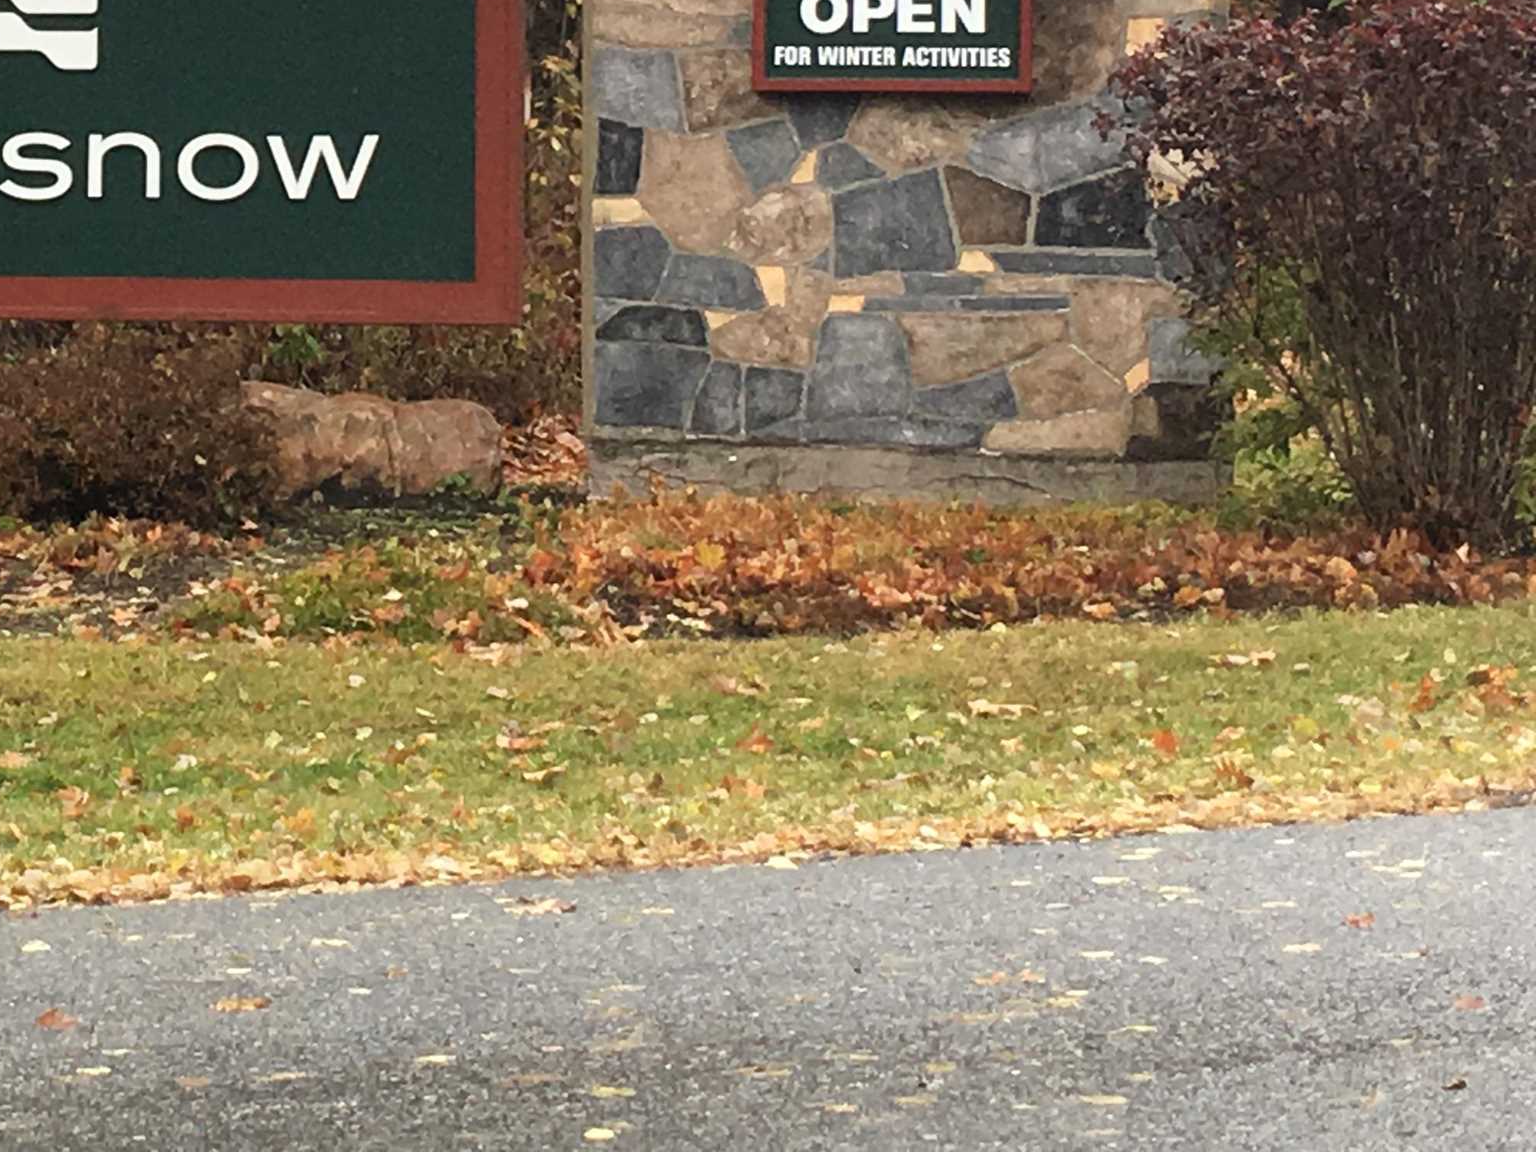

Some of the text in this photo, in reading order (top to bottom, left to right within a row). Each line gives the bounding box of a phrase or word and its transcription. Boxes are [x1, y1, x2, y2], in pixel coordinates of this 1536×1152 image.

[774, 46, 1010, 67] FOR WINTER ACTIVITIES
